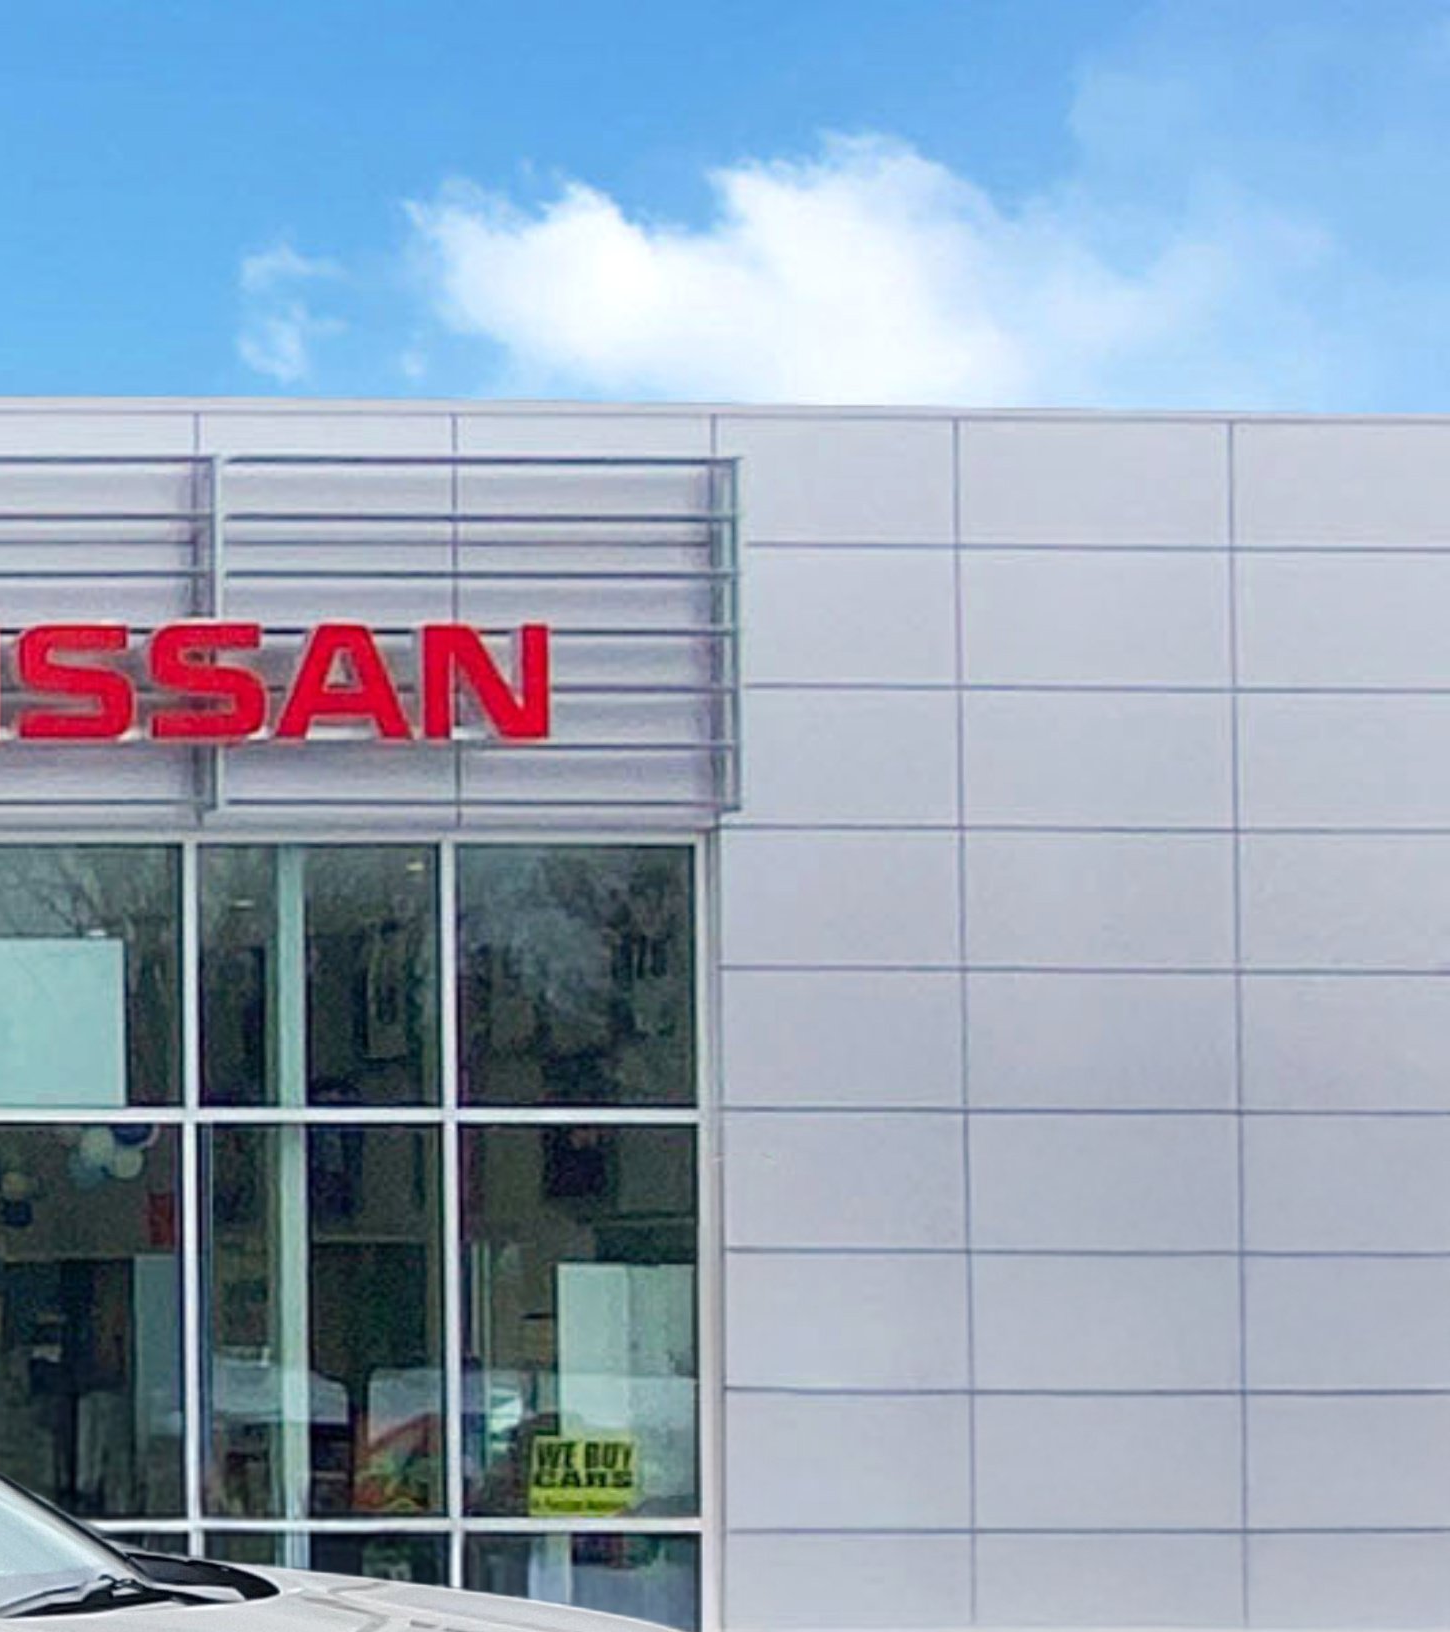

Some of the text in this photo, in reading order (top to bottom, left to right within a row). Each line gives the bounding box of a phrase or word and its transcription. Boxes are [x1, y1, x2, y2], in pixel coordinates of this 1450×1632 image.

[536, 1441, 633, 1470] WE BUY
[534, 1469, 633, 1489] CARS
